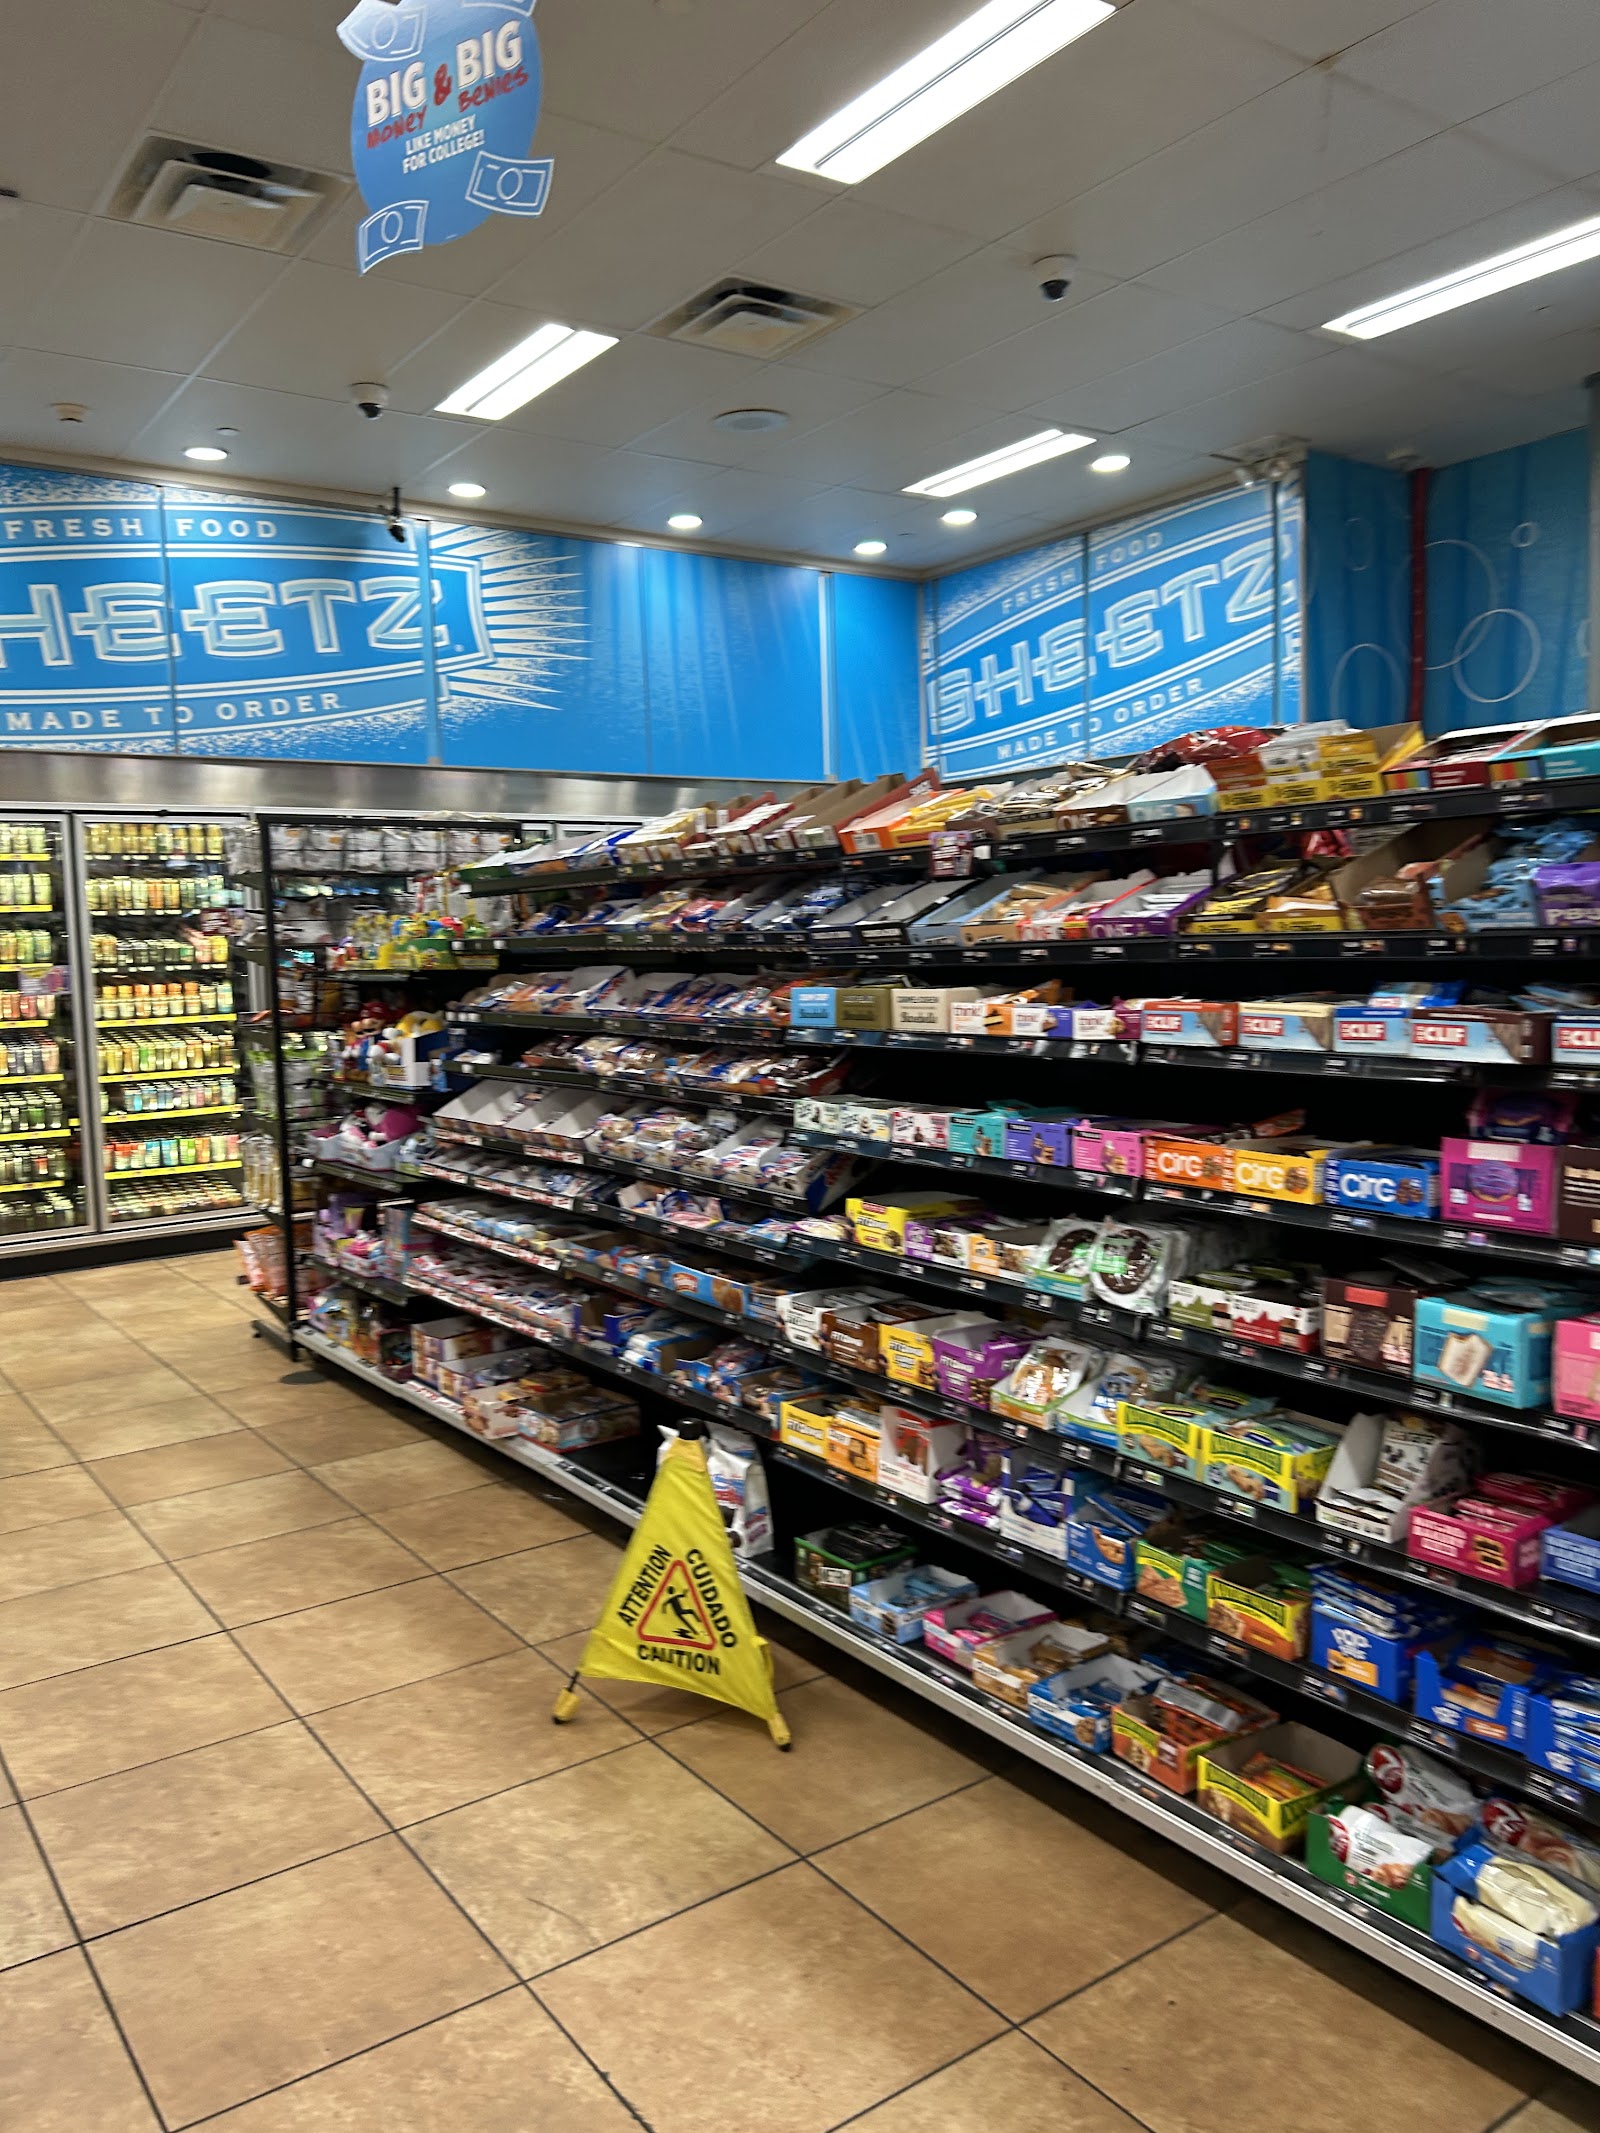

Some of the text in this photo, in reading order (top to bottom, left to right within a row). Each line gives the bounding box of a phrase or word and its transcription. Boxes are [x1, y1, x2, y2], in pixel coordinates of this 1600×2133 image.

[367, 20, 523, 128] BIG & BIG
[403, 129, 485, 174] FOR COLLEGE!
[406, 114, 476, 155] LIKE MONEY
[3, 517, 277, 540] FRESH FOOD
[1002, 532, 1163, 615] FRESH FOOD
[927, 537, 1298, 736] SHEETZ
[6, 692, 340, 730] MADE TO ORDER
[997, 677, 1204, 760] MADE TO ORDER
[1350, 1022, 1385, 1040] CLIF
[1425, 1025, 1466, 1045] CLIF
[617, 1544, 673, 1627] ATTENTION
[686, 1549, 738, 1648] CUIDADO
[637, 1644, 720, 1676] CAUTION
